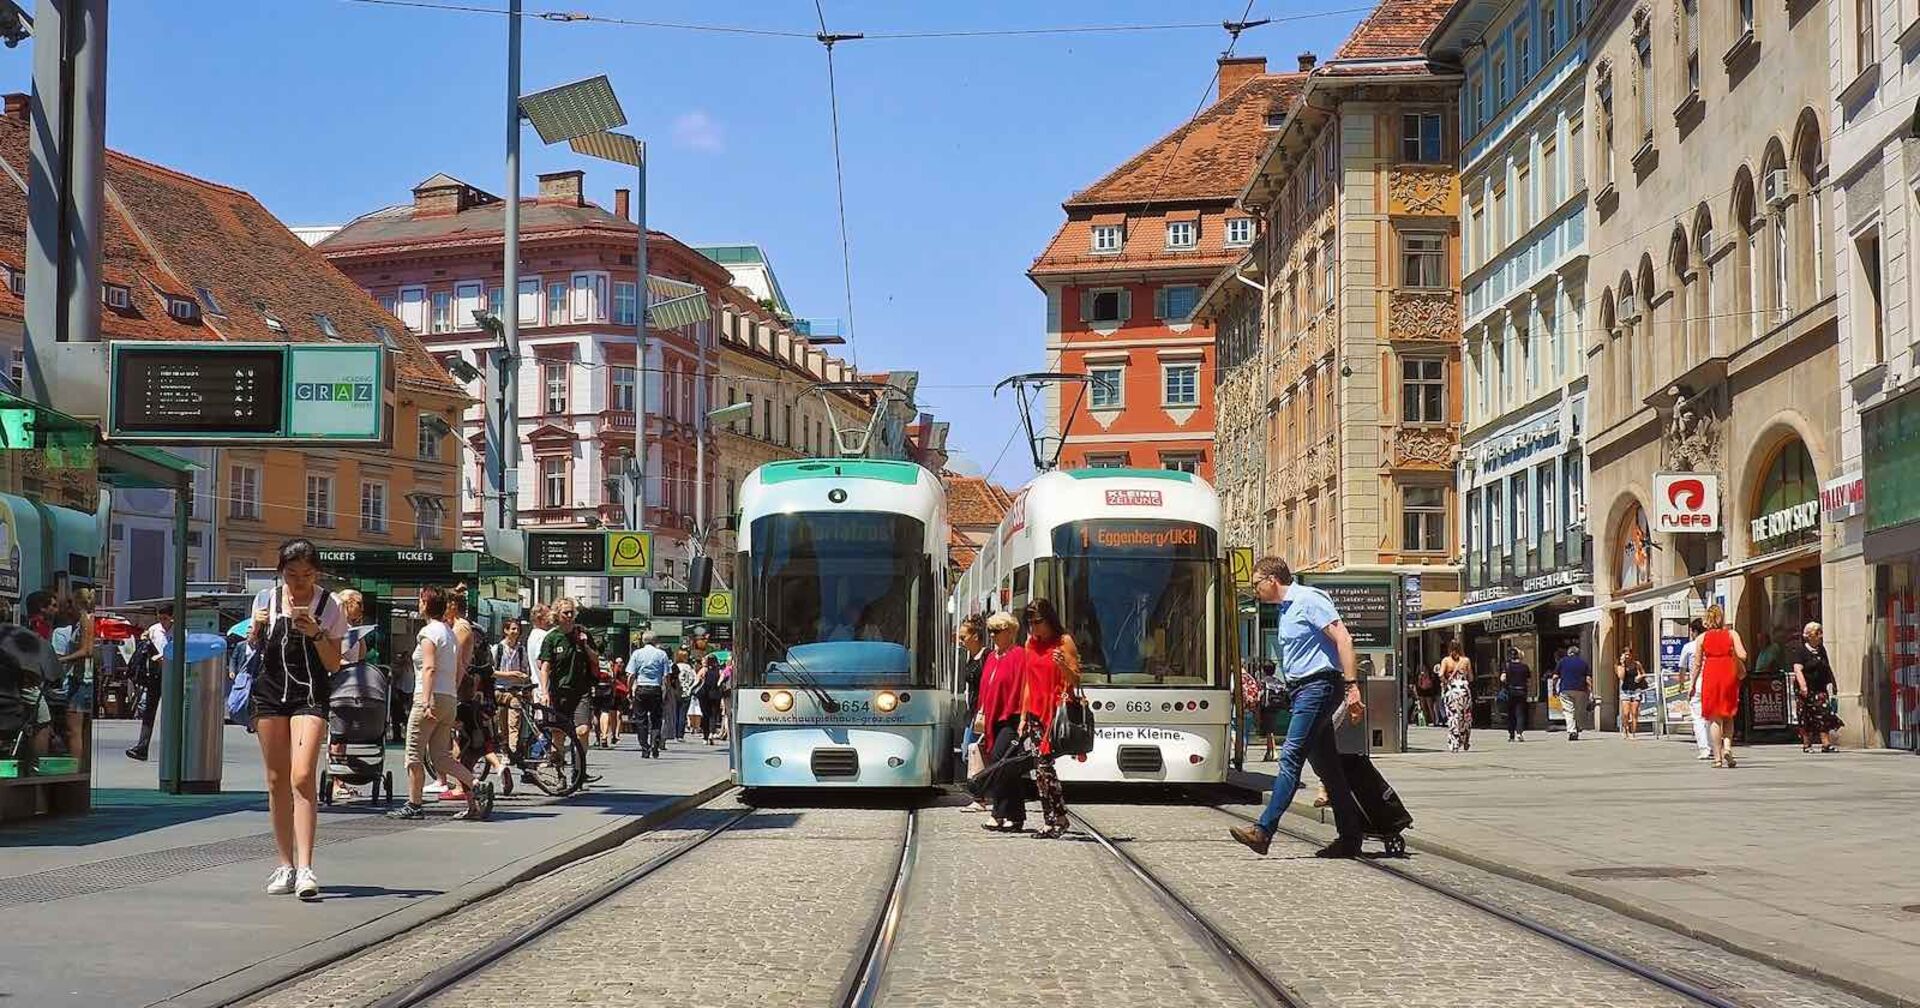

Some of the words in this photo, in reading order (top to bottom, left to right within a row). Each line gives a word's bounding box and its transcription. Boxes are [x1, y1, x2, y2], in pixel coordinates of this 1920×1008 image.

[298, 385, 369, 399] GRAZ
[1107, 489, 1160, 498] KLEINE
[1821, 484, 1846, 512] TALLY
[1108, 496, 1161, 505] ZEITUNG
[1661, 513, 1712, 528] ruefa
[1751, 516, 1768, 543] THE
[1769, 507, 1793, 538] BODY
[1793, 500, 1818, 531] SHOP
[1080, 526, 1088, 548] 1
[1098, 527, 1197, 547] Eggenberg/UKH
[319, 551, 356, 561] TICKETS
[397, 551, 434, 561] TICKETS
[1483, 611, 1535, 633] WEIKHARD
[1753, 692, 1783, 705] SALE
[1126, 700, 1152, 713] 663
[1094, 728, 1134, 740] Meine
[1137, 728, 1184, 741] Kleine.
